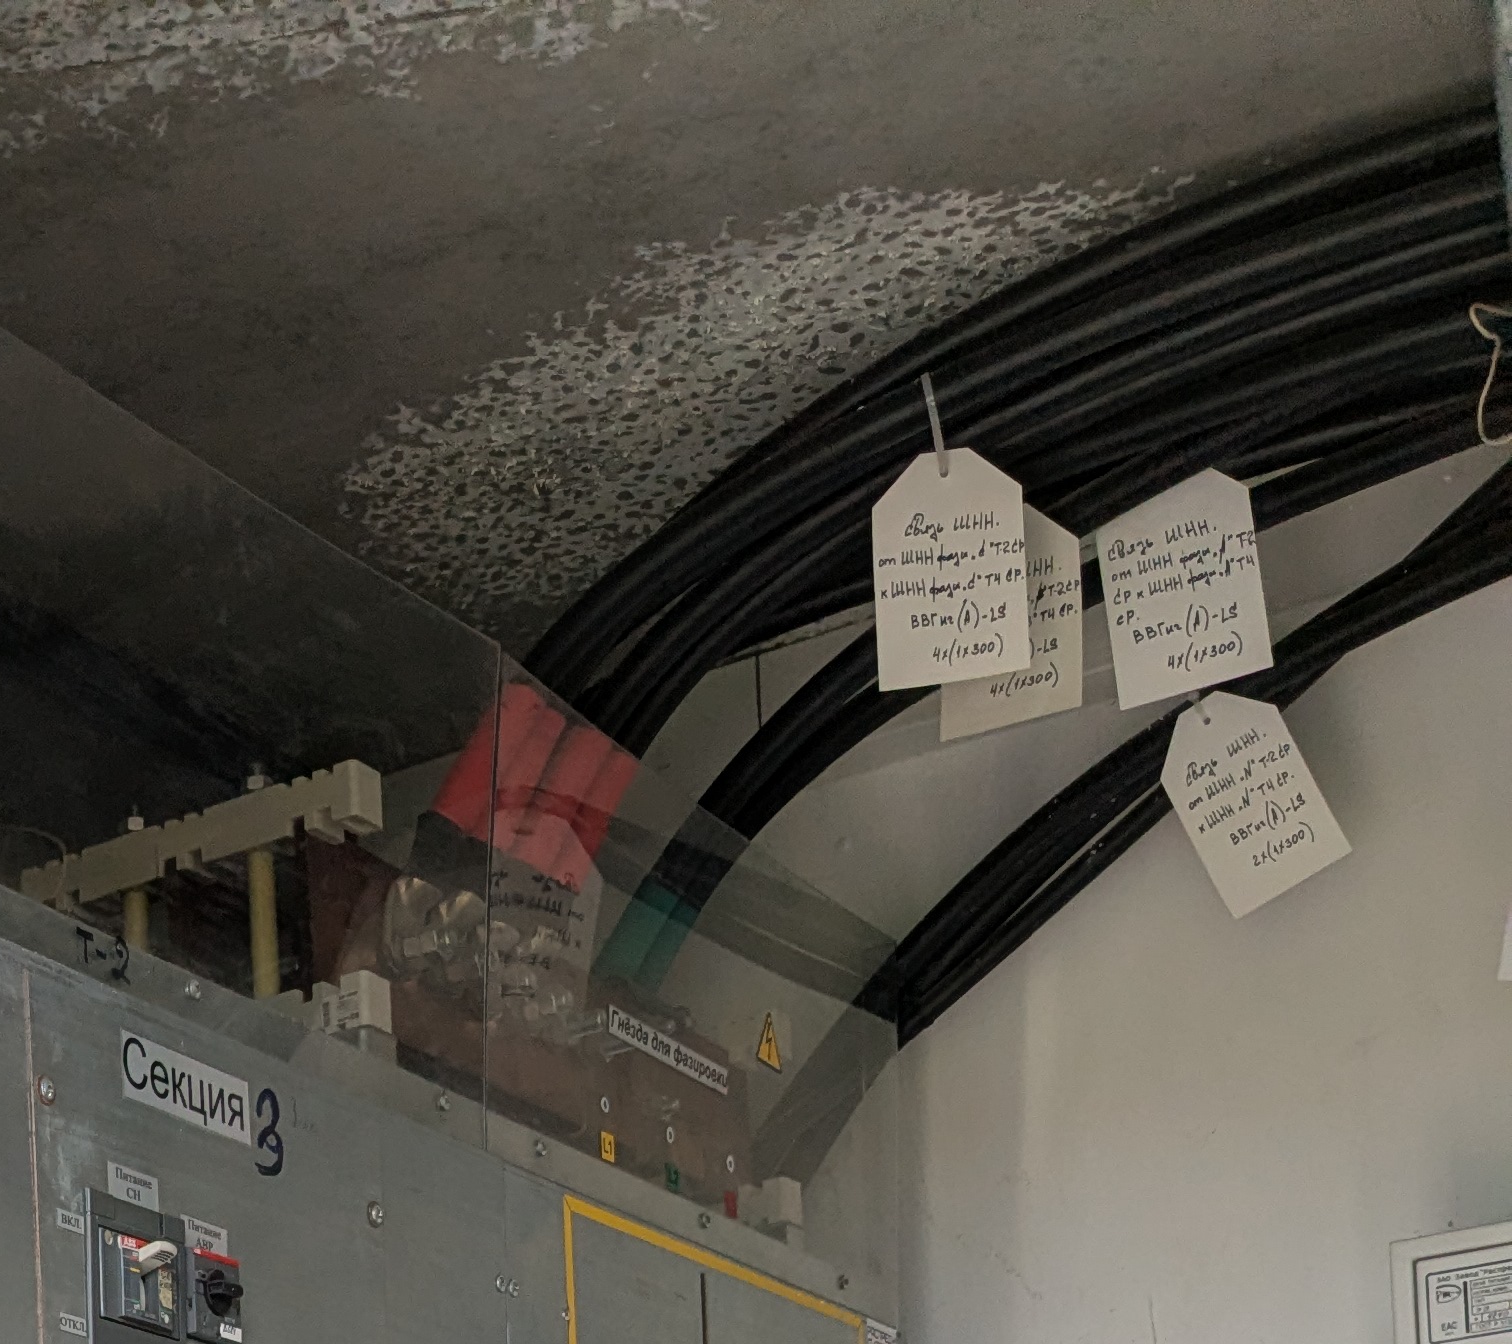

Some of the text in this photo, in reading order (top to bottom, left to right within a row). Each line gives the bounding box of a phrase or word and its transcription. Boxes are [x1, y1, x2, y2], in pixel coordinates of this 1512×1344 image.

[901, 547, 934, 566] ШНН
[1137, 552, 1173, 575] ШНН
[891, 578, 926, 599] ШНН
[1148, 573, 1183, 596] ШНН
[651, 1031, 671, 1053] для
[122, 1037, 245, 1131] Секция
[603, 1137, 613, 1155] L1
[126, 1187, 141, 1201] СН
